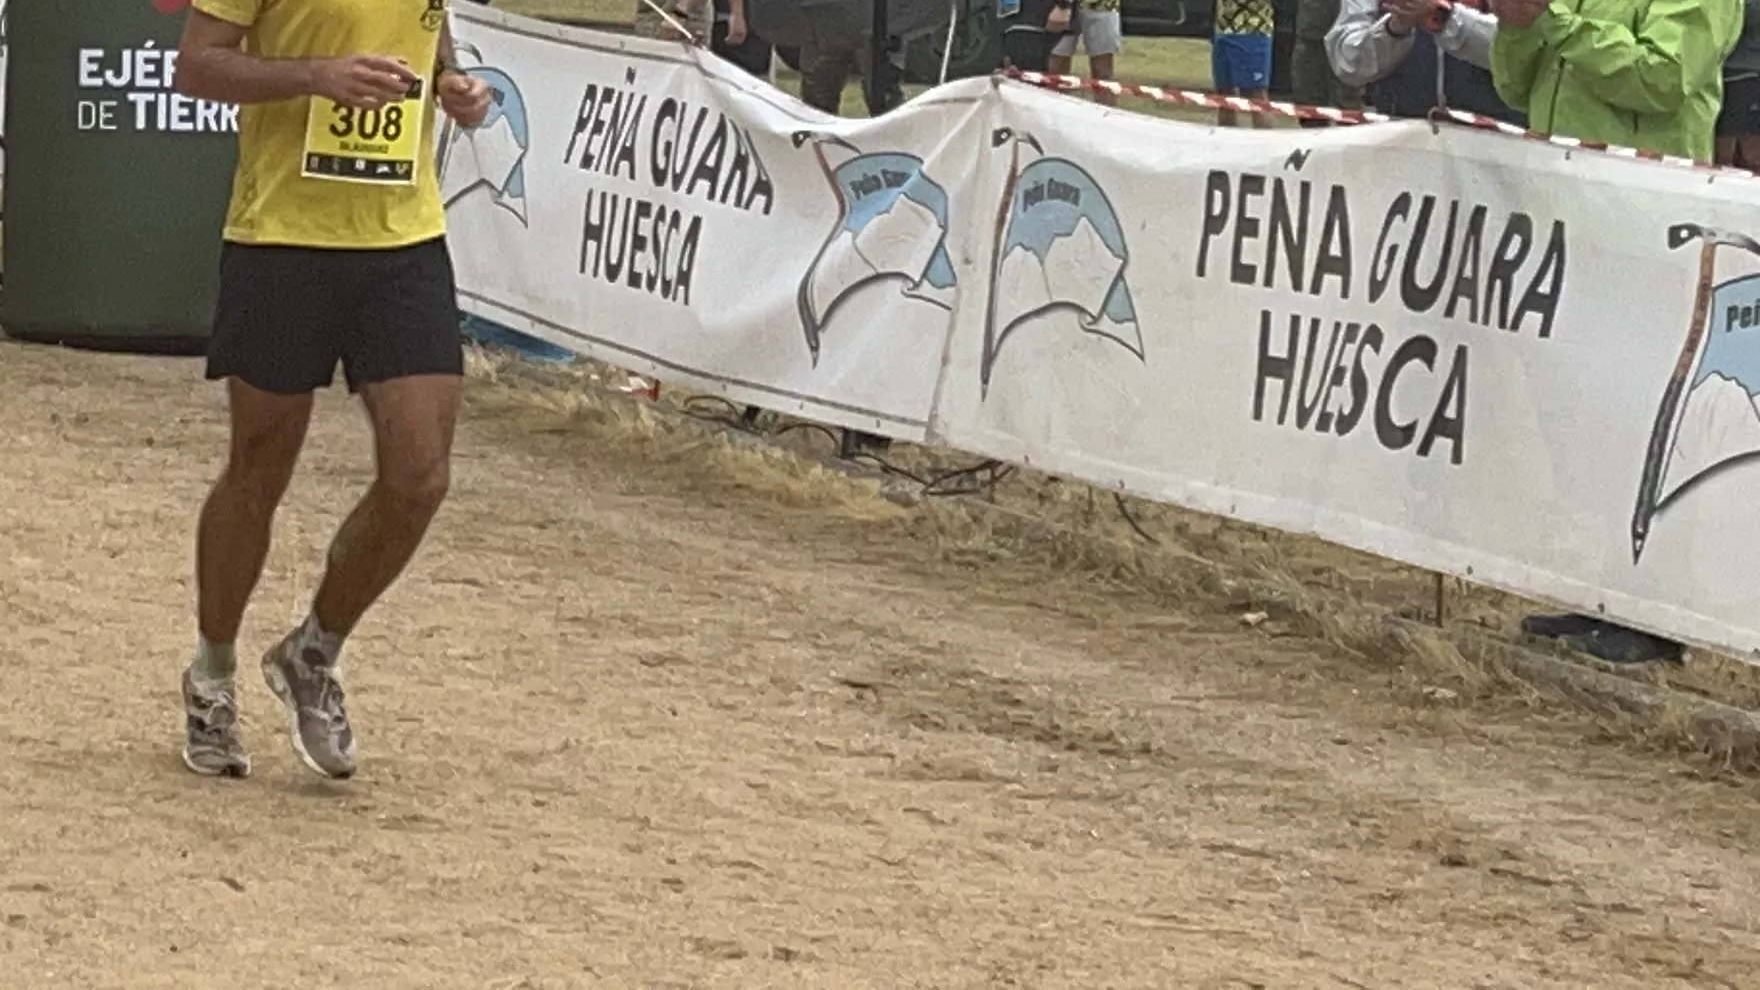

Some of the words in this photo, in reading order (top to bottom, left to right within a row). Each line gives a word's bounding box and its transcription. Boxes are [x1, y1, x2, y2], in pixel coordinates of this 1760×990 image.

[78, 101, 118, 130] DE
[329, 105, 403, 142] 308
[564, 67, 648, 181] PEÑA
[651, 97, 774, 216] GUARA
[579, 188, 702, 306] HUESCA
[1196, 148, 1353, 300] PEÑA
[1368, 191, 1566, 338] GUARA
[1253, 309, 1468, 465] HUESCA
